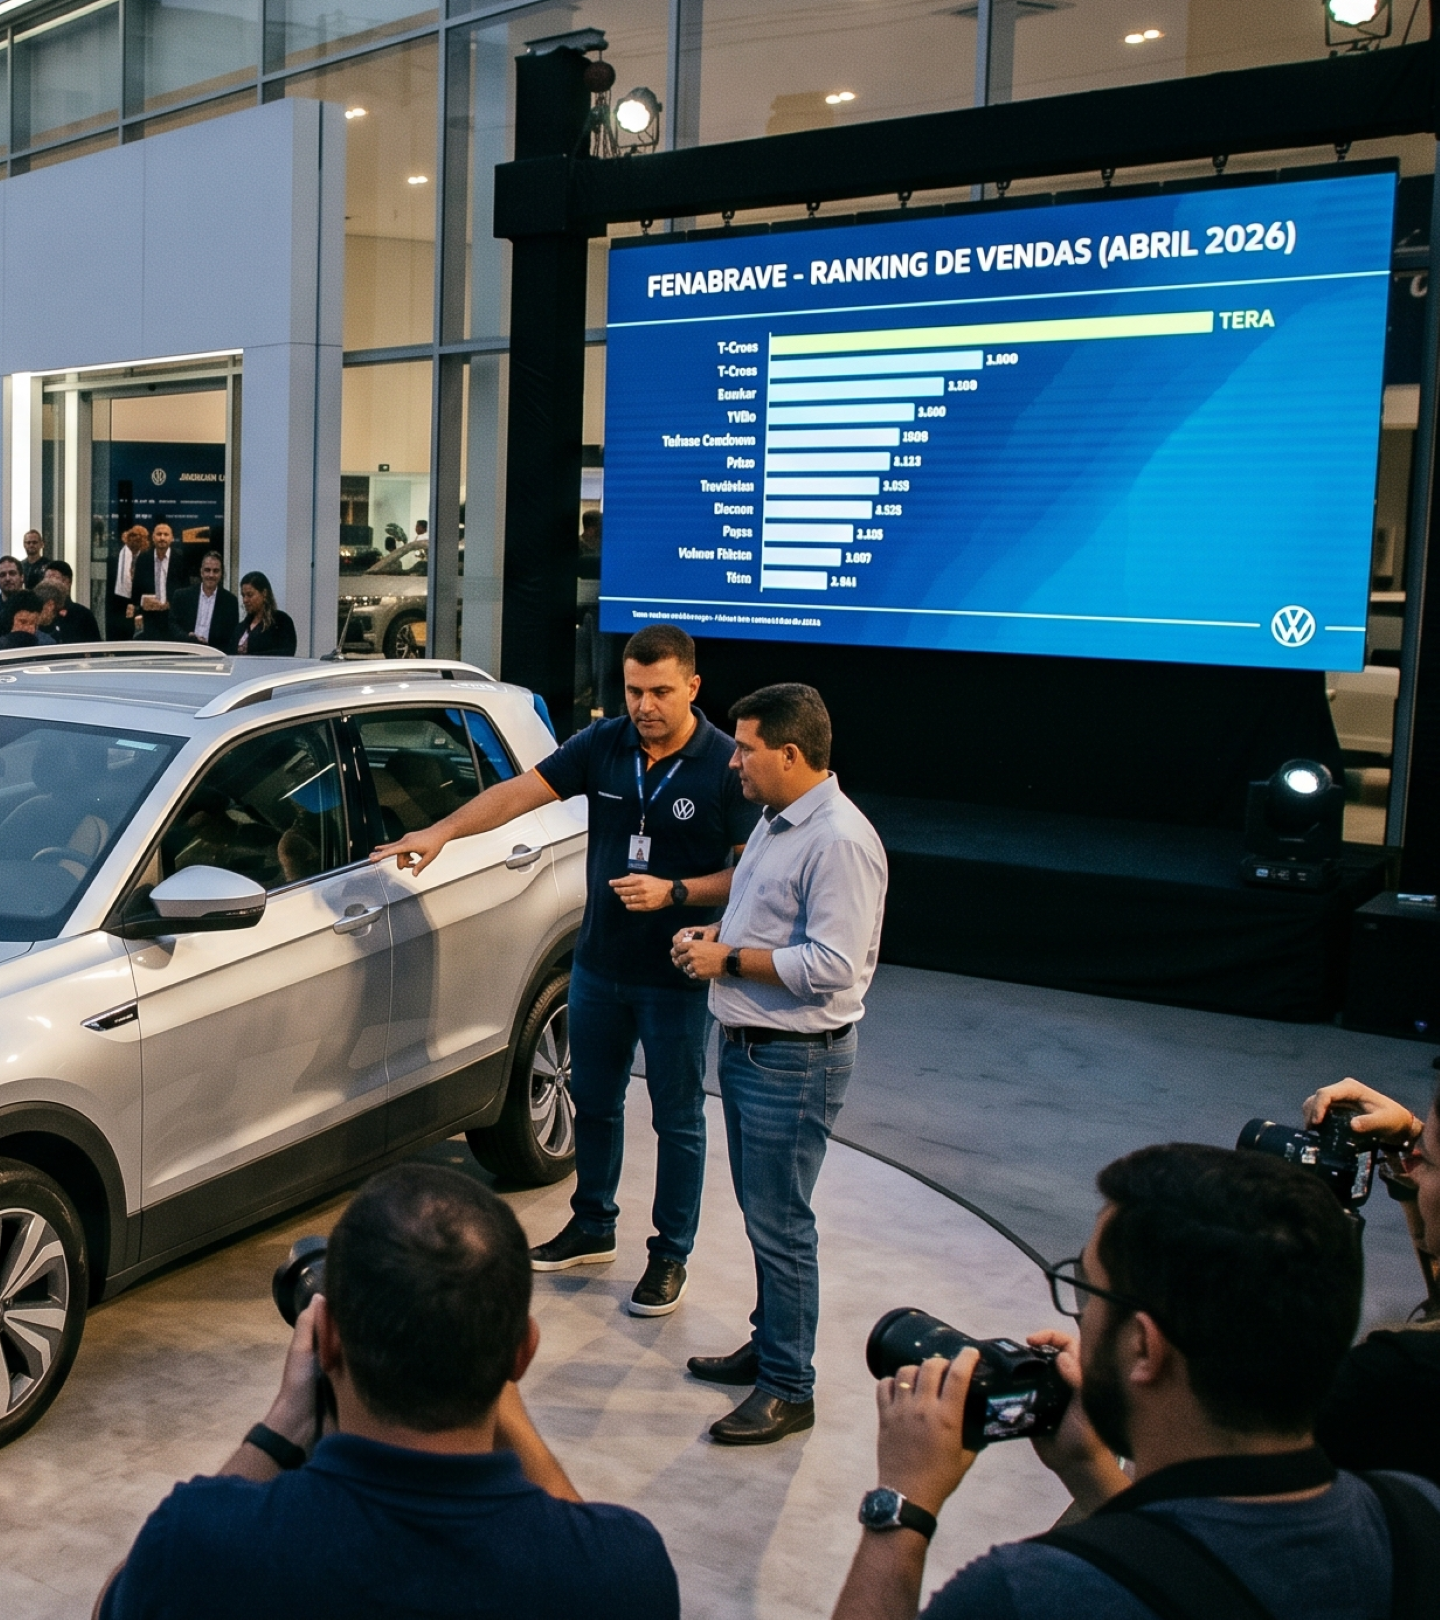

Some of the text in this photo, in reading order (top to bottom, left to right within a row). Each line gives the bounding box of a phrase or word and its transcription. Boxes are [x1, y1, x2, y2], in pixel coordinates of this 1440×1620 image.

[647, 264, 787, 298] FENABRAVE
[810, 252, 928, 285] RANKING
[935, 248, 971, 275] DE
[977, 238, 1092, 272] VENDAS
[1099, 230, 1198, 269] (ABRIL
[1205, 220, 1297, 255] 2026)
[1219, 309, 1275, 329] TERA
